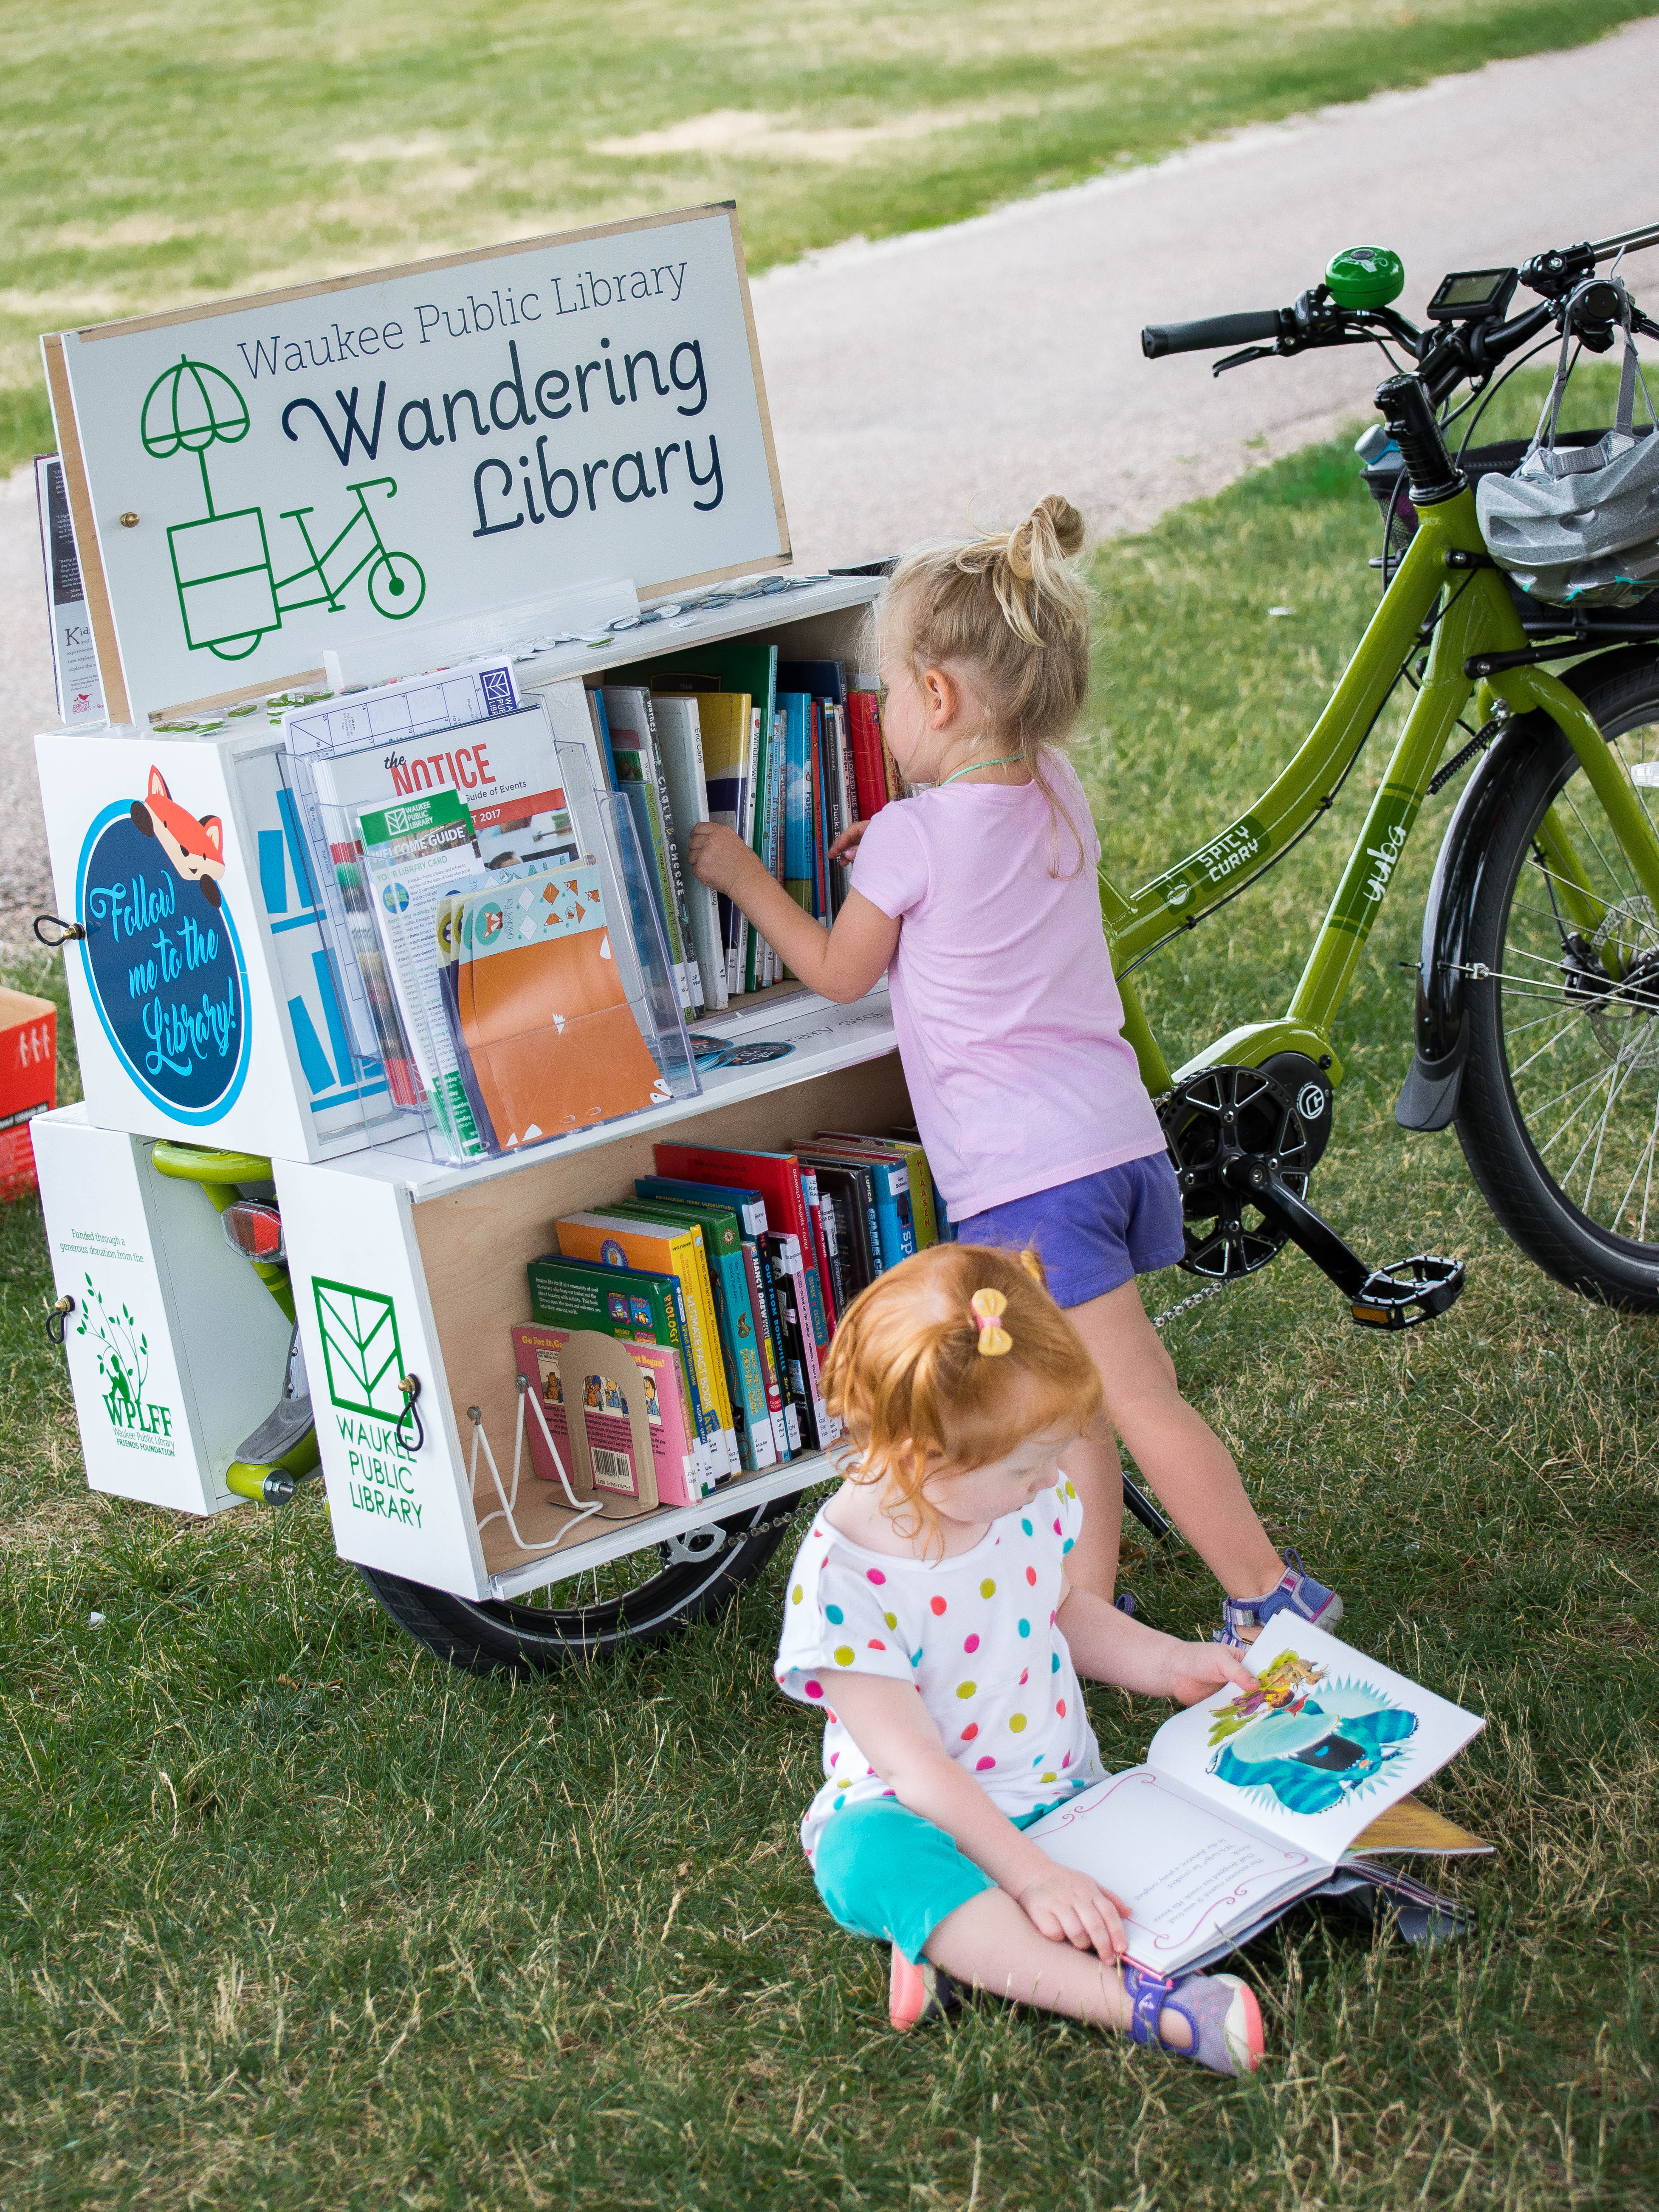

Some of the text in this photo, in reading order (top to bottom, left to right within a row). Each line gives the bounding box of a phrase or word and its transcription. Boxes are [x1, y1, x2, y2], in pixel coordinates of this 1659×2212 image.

[237, 262, 687, 379] Waukee Public Library
[282, 338, 707, 466] Wandering
[473, 434, 724, 538] Library
[384, 751, 406, 769] the
[391, 743, 496, 797] NOTICE
[751, 732, 760, 784] Windblown
[500, 781, 527, 793] Events
[405, 801, 431, 814] WAUKEE
[408, 810, 429, 821] PUBLIC
[479, 809, 501, 822] 2017
[648, 792, 657, 821] Willems
[409, 817, 433, 830] LIBRARY
[428, 827, 465, 847] GUIDE
[1197, 825, 1250, 868] SPICY
[428, 856, 447, 867] CARD
[1208, 839, 1259, 883] CURRY
[1363, 825, 1407, 902] yuba
[90, 870, 175, 943] Follow
[129, 915, 218, 999] me to the
[143, 976, 236, 1076] Library!
[895, 1180, 907, 1188] School
[917, 1159, 930, 1227] HIAASEN
[71, 1229, 95, 1241] Funded
[95, 1233, 121, 1247] through
[867, 1208, 880, 1256] GAME
[60, 1243, 144, 1263] generous donation from the
[672, 1242, 691, 1251] WOJTANIK
[680, 1253, 689, 1286] GEOGRAPHIC
[752, 1258, 763, 1289] NANCY
[758, 1292, 767, 1318] DREW
[769, 1288, 778, 1316] FROM
[663, 1294, 679, 1343] BIOLOGY
[808, 1275, 817, 1299] BINK
[813, 1309, 824, 1340] GOLLIE
[522, 1335, 554, 1349] Go For It,
[681, 1323, 697, 1386] Space Exploration
[686, 1295, 713, 1409] ULTIMATE FACT BOOK
[773, 1319, 786, 1371] BONEVILLE
[639, 1354, 665, 1368] Begun!
[743, 1348, 758, 1415] SURVIVAL GUIDE
[102, 1394, 172, 1437] WPLFF
[113, 1427, 174, 1450] Waukee Public Library
[116, 1438, 175, 1457] FRIENDS FOUNDATION
[336, 1414, 418, 1463] WAUKEE
[700, 1428, 708, 1444] GREEN
[349, 1450, 415, 1494] PUBLIC
[606, 1481, 631, 1490] 0-345-37579-3
[350, 1481, 422, 1529] LIBRARY
[1213, 1861, 1238, 1879] dropped
[1239, 1852, 1254, 1864] Duff
[1251, 1857, 1265, 1865] The
[1202, 1877, 1214, 1886] his
[1225, 1865, 1250, 1882] monster
[1154, 1907, 1172, 1922] knees
[1172, 1899, 1184, 1909] His
[1183, 1902, 1196, 1911] was
